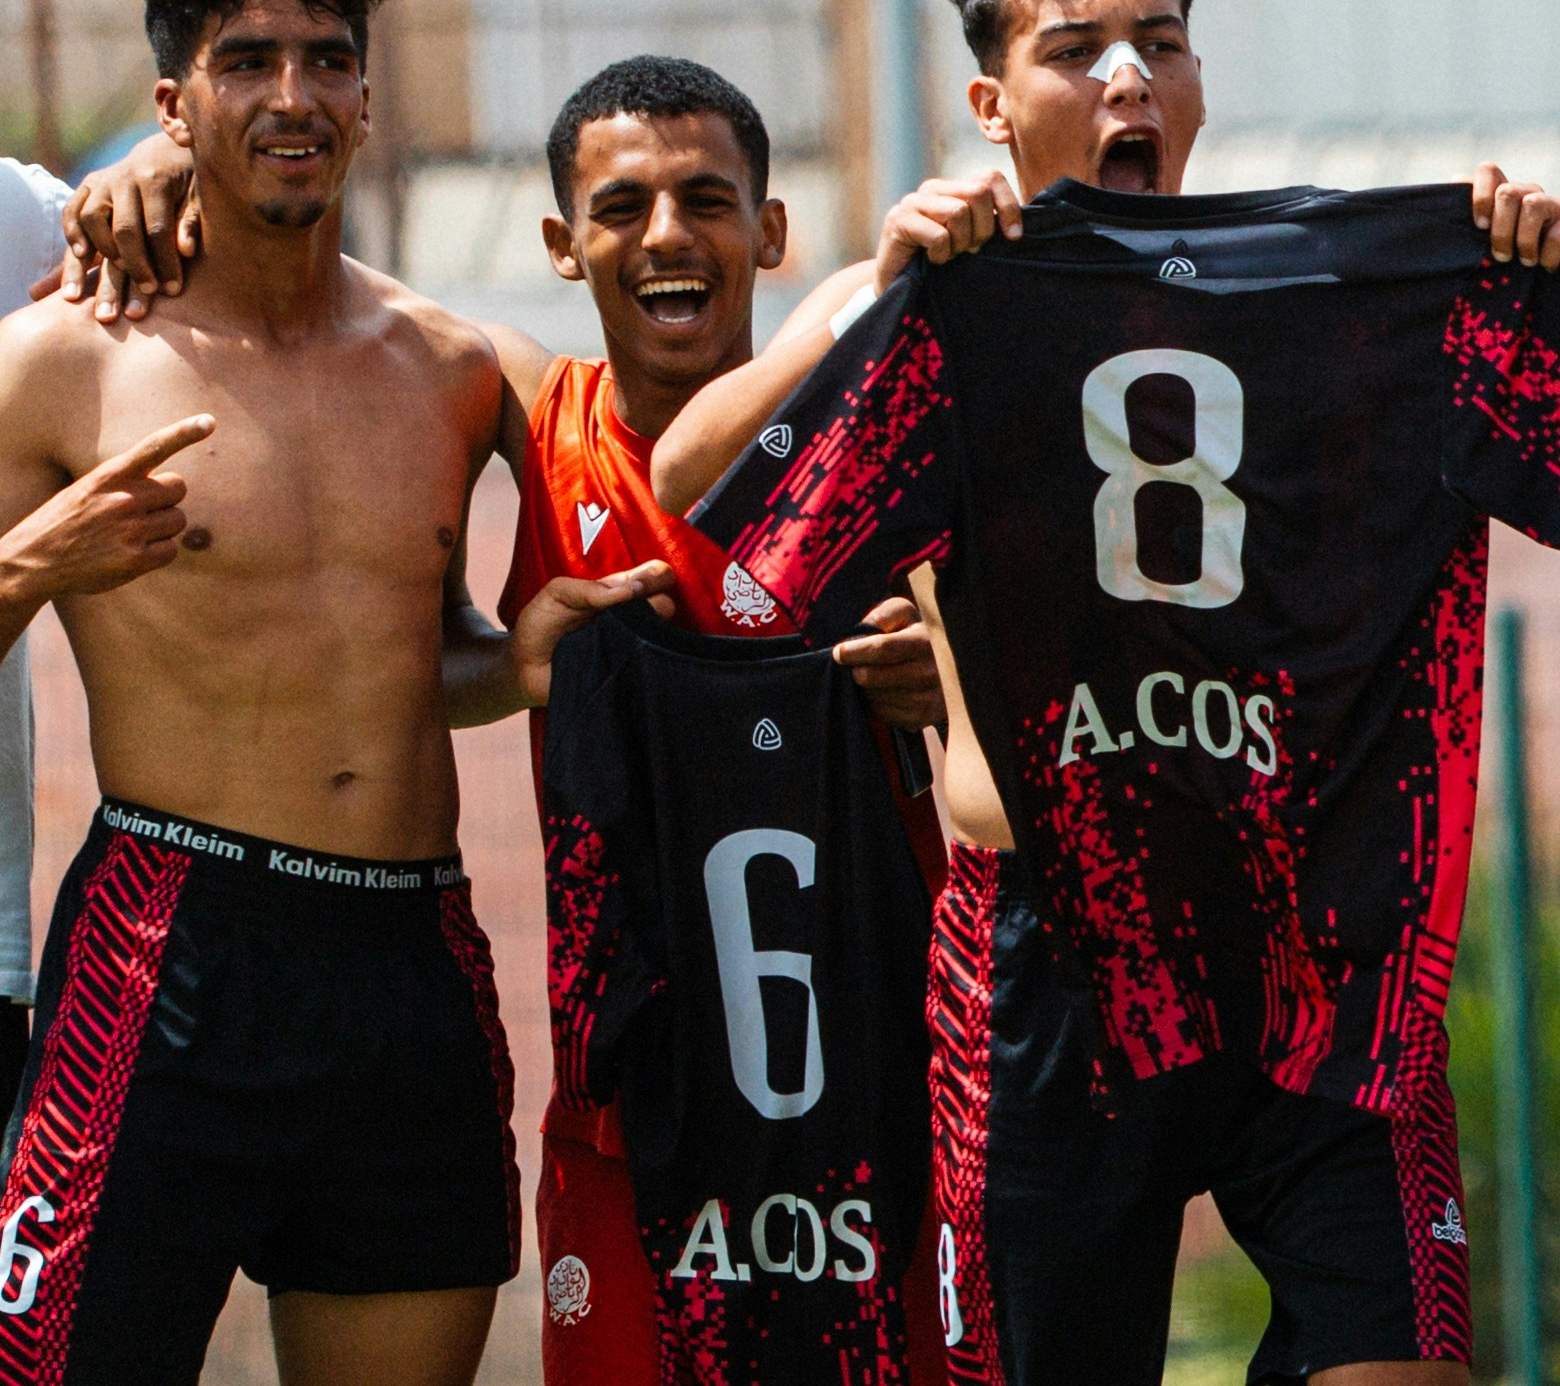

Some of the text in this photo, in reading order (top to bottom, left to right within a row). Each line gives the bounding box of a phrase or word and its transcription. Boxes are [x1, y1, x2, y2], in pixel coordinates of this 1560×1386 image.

[1081, 348, 1247, 609] 8
[1058, 671, 1278, 776] A.COS
[103, 804, 161, 838] Kalvim
[163, 821, 245, 861] Kleim
[268, 849, 361, 887] Kalvim
[364, 867, 421, 889] Kleim
[704, 828, 824, 1120] 6
[0, 1195, 55, 1315] 6
[670, 1193, 876, 1282] A.COS
[938, 1222, 964, 1347] 8
